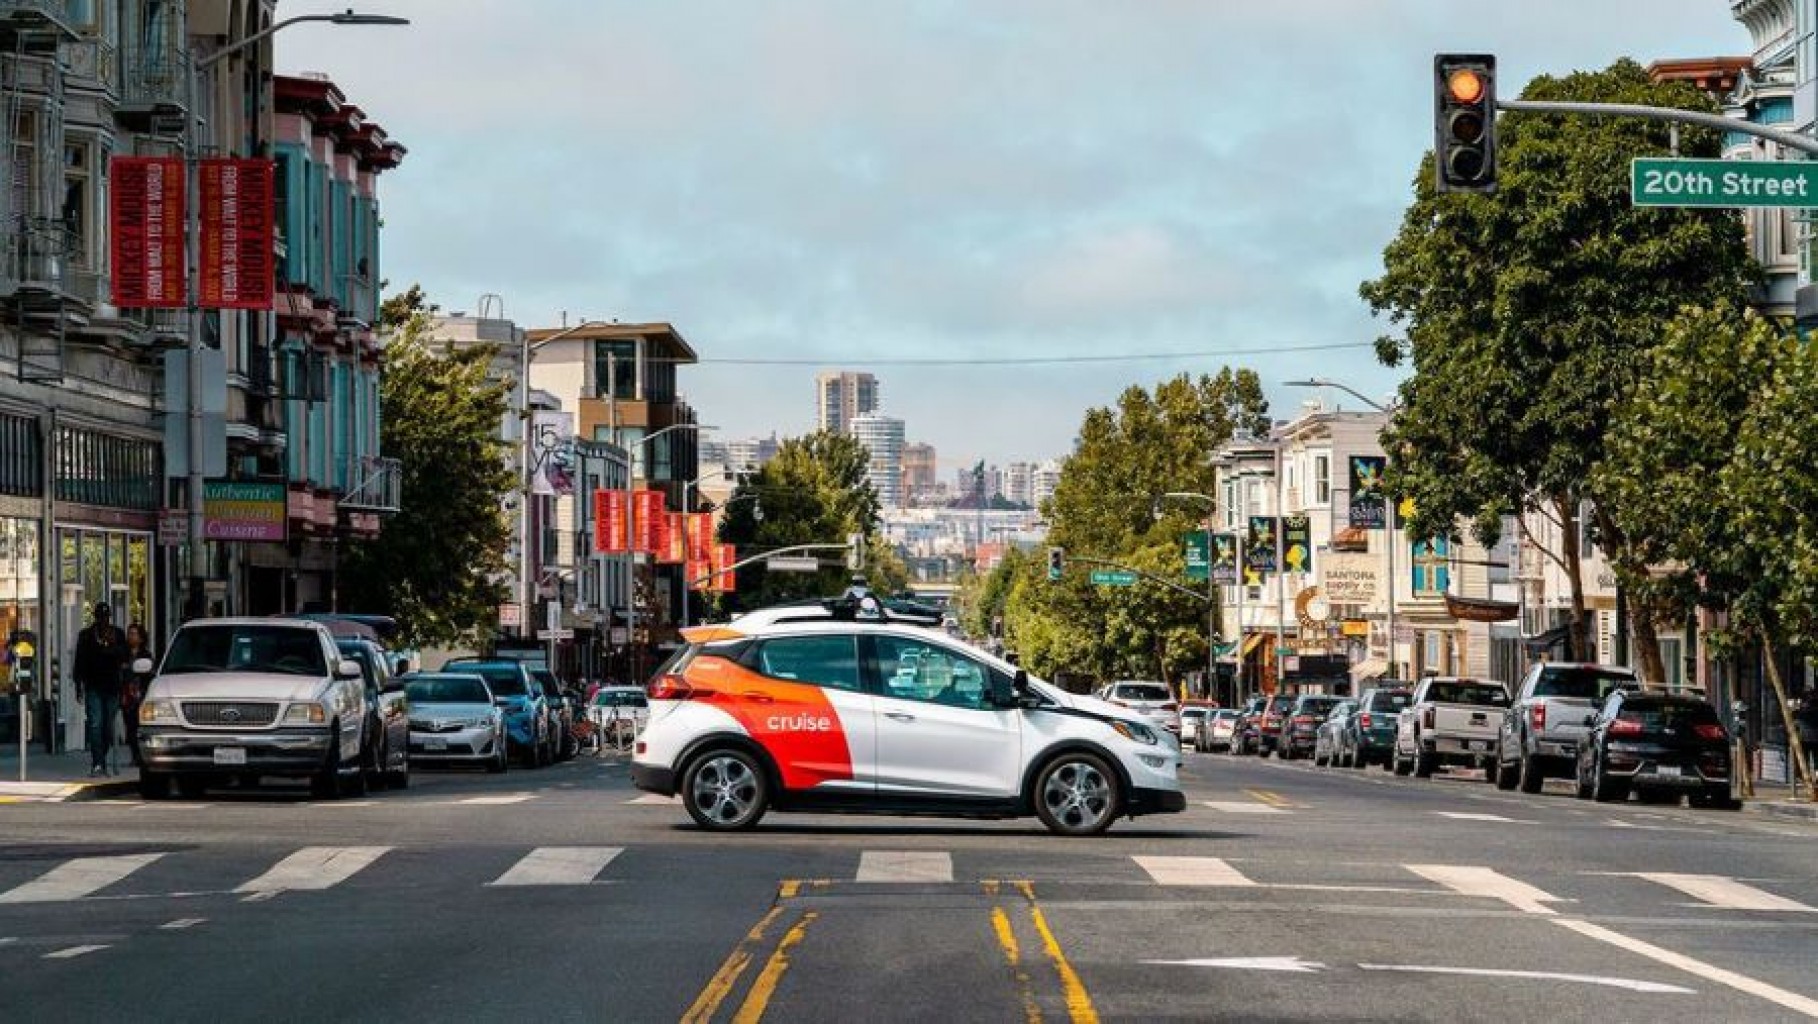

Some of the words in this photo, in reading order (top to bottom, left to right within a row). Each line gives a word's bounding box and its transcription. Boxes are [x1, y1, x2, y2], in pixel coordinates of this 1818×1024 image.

[147, 163, 162, 201] WORLD
[222, 165, 237, 195] FROM
[1643, 169, 1714, 195] 20th
[1722, 171, 1808, 196] Street
[119, 164, 144, 227] MOUSE
[147, 203, 162, 222] THE
[147, 223, 162, 237] TO
[119, 235, 144, 299] MICKEY
[240, 239, 265, 301] MOUSE
[147, 270, 162, 300] FROM
[222, 264, 237, 301] WORLD
[207, 519, 267, 537] Cuisine
[767, 712, 831, 732] cruise
